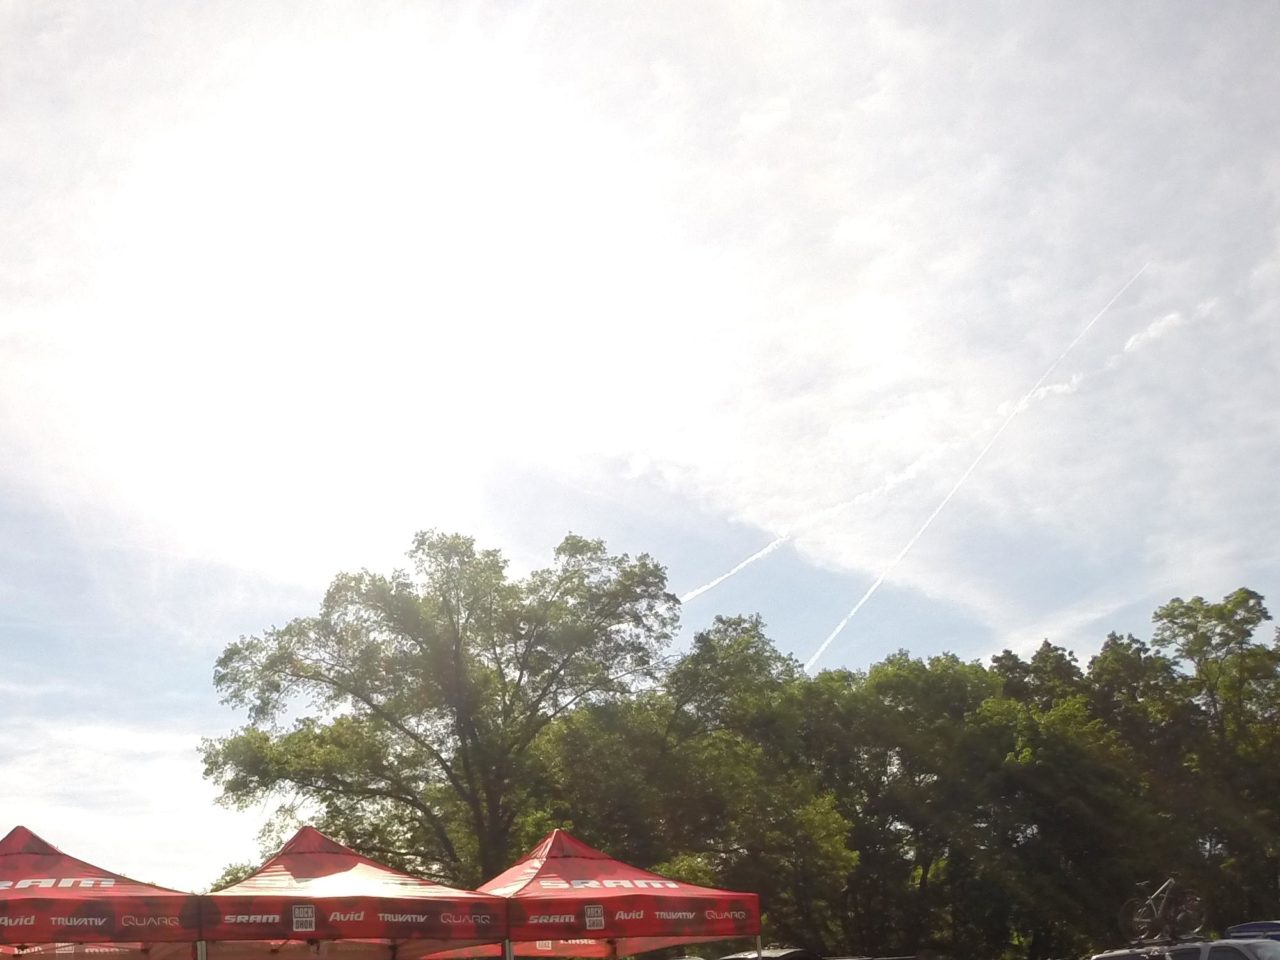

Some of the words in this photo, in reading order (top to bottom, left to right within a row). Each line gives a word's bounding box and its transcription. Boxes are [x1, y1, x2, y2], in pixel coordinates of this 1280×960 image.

[540, 880, 679, 889] SRAM
[224, 914, 280, 923] SRAM
[328, 911, 364, 922] Avid
[378, 913, 428, 923] TRUVATIV
[528, 914, 575, 924] SRAM
[615, 910, 644, 921] Avid
[50, 917, 107, 927] TRUVATIV
